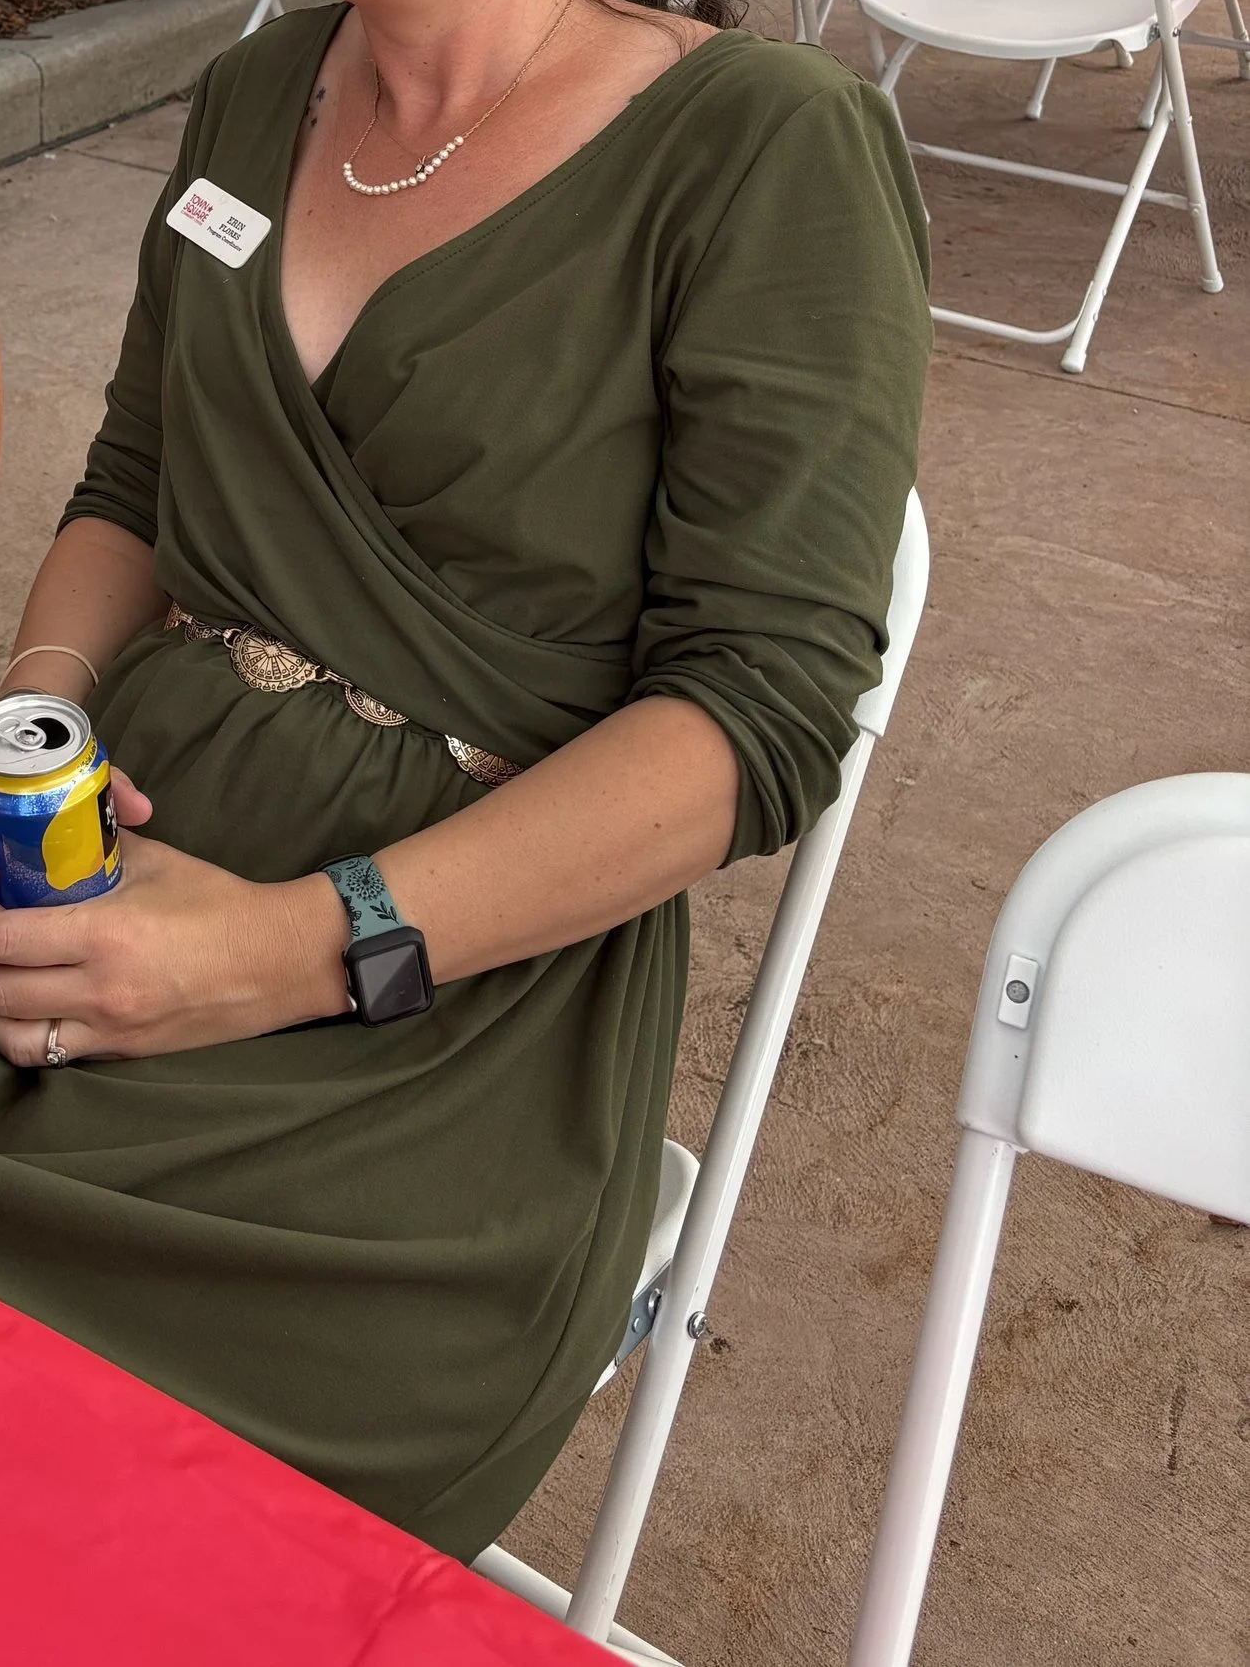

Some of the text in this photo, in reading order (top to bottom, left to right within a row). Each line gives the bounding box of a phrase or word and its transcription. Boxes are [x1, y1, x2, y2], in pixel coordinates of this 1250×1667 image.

[190, 193, 210, 211] TOWN
[183, 202, 209, 222] SQUARE
[206, 225, 222, 240] Program
[218, 223, 241, 241] FLORES
[226, 216, 246, 232] ERIN
